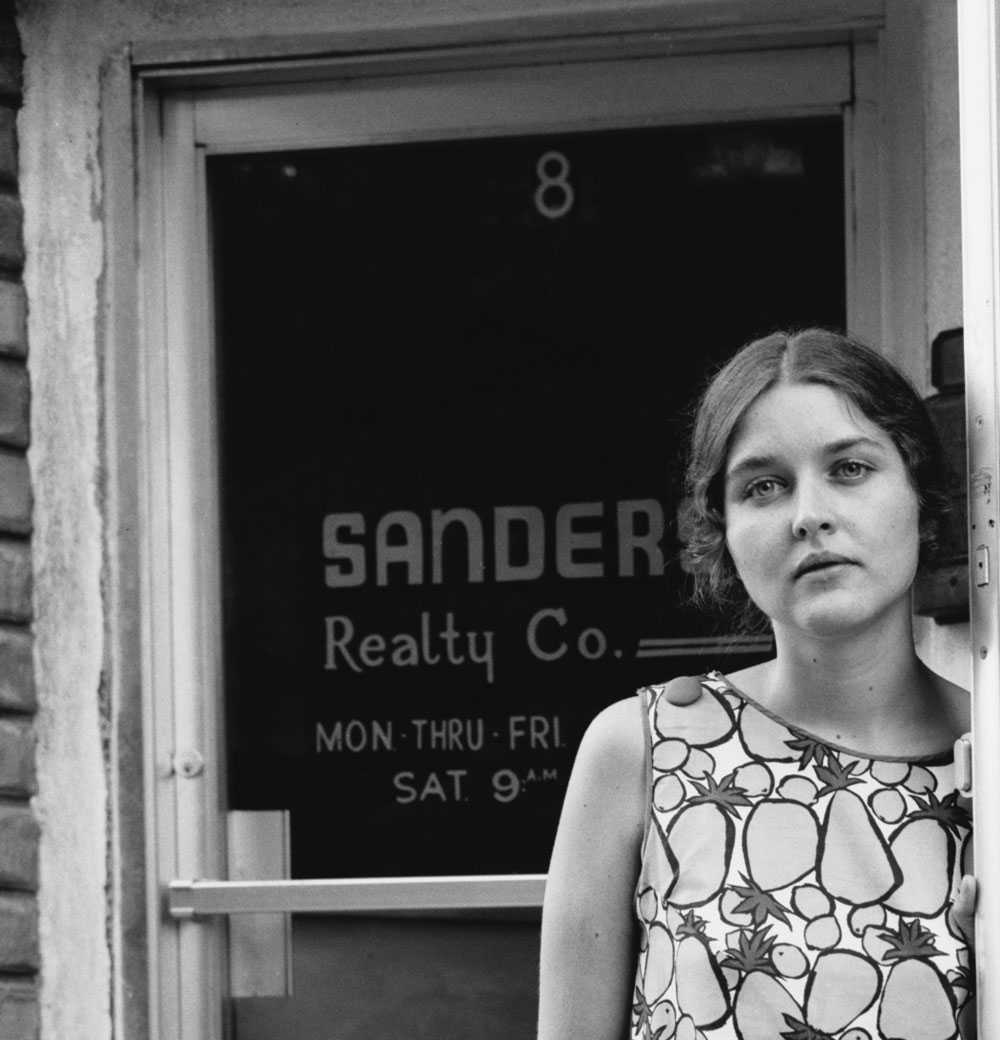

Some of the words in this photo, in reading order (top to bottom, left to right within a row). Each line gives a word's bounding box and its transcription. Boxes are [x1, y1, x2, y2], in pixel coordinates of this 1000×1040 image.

[535, 151, 574, 218] 8
[323, 611, 495, 683] Realty
[527, 607, 623, 661] Co.
[412, 718, 483, 750] THRU
